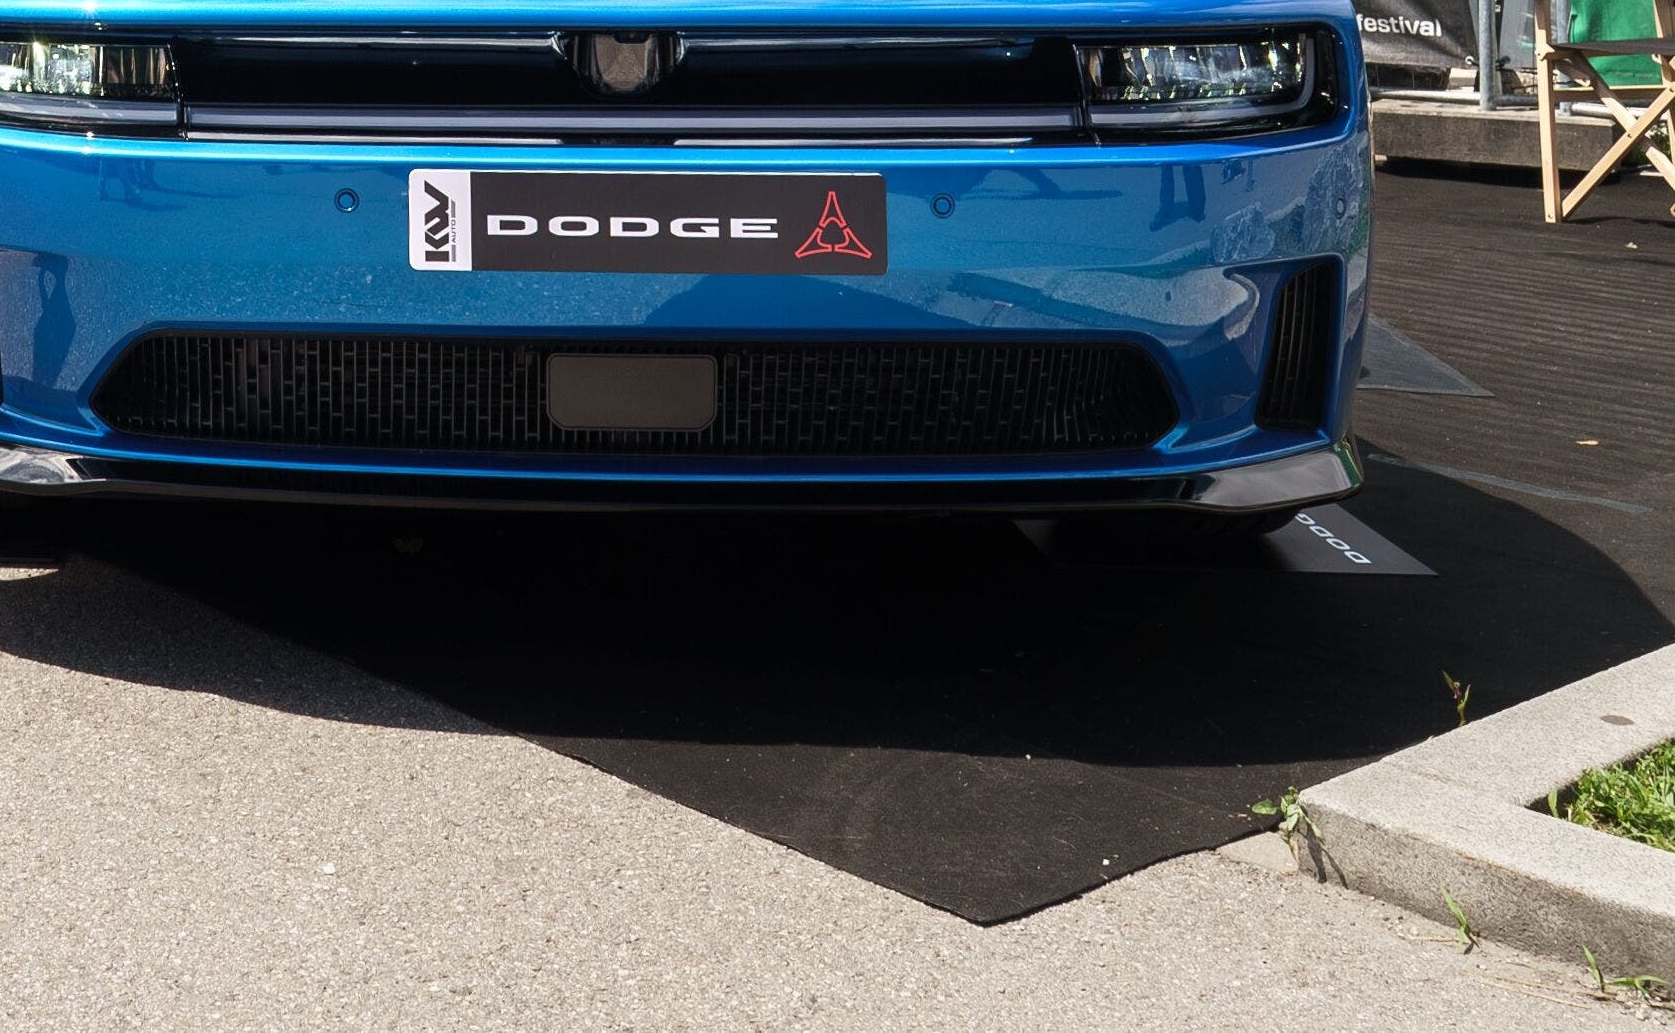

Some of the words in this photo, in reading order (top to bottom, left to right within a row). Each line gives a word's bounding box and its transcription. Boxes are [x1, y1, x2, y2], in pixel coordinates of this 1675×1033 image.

[424, 179, 450, 263] KW
[487, 214, 779, 240] DODGE
[1294, 512, 1373, 565] DODG
